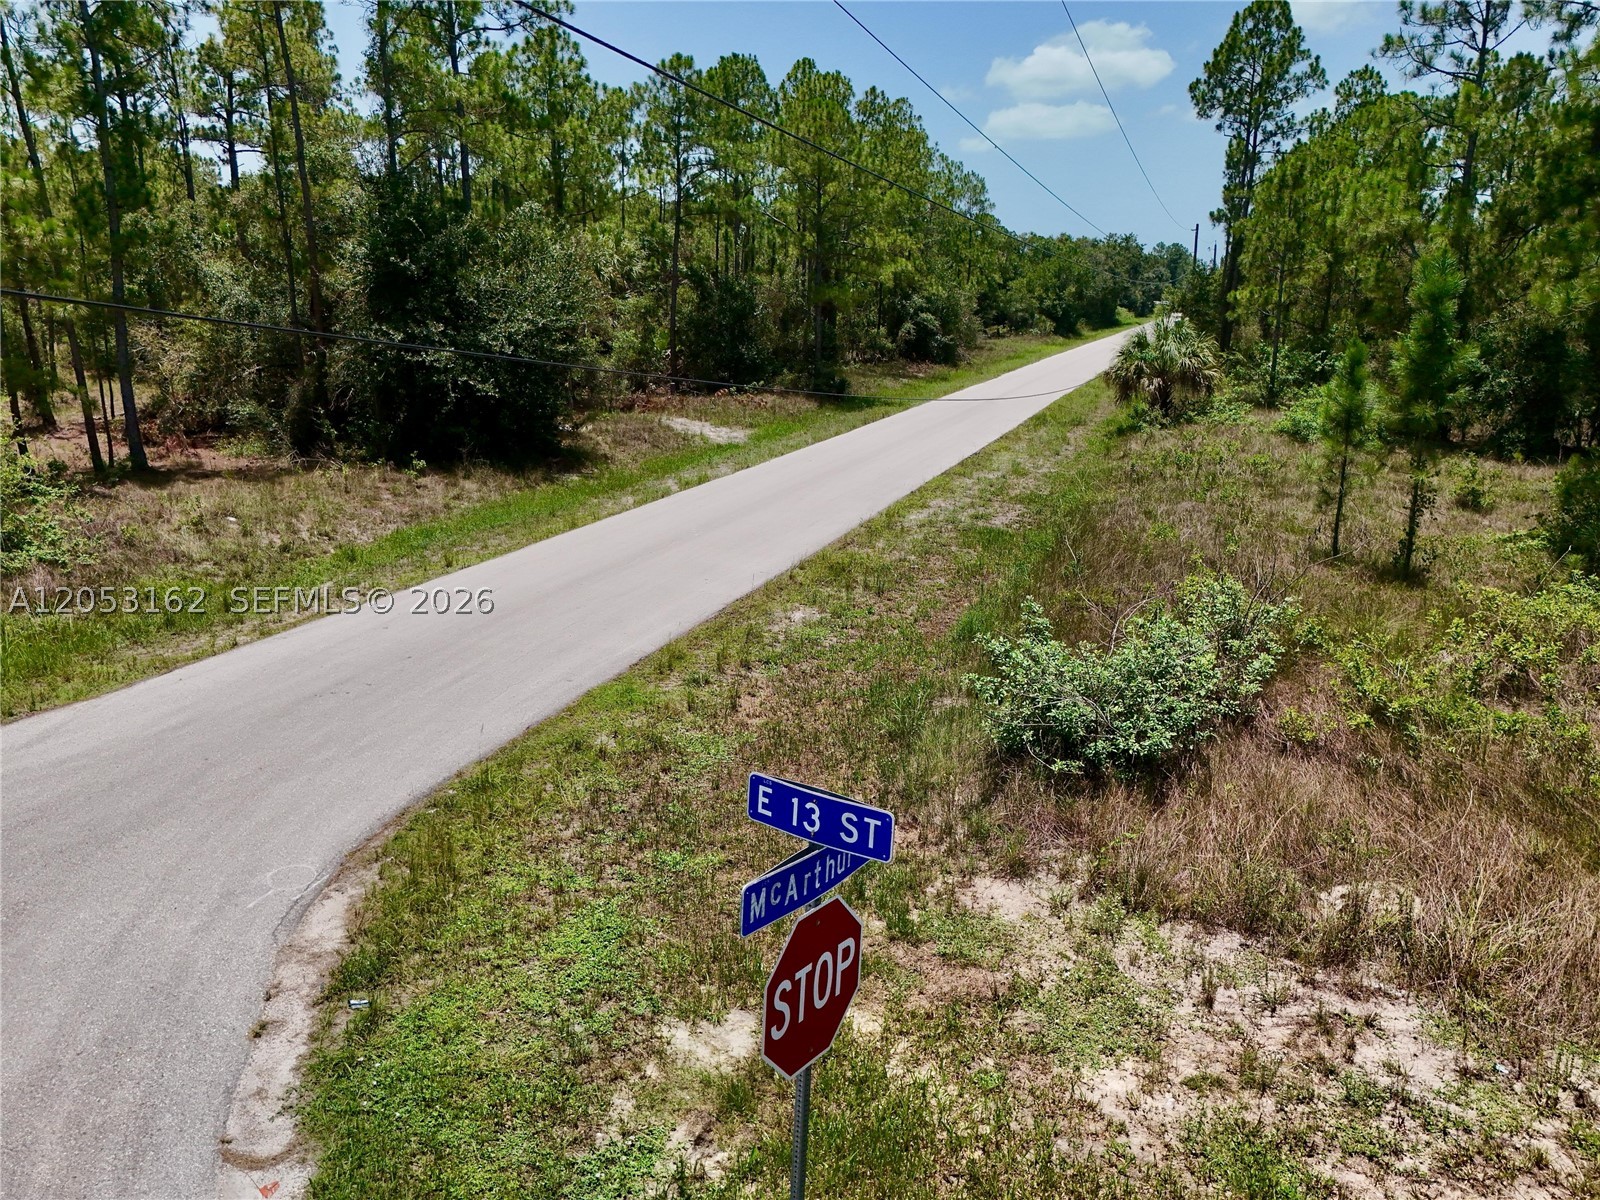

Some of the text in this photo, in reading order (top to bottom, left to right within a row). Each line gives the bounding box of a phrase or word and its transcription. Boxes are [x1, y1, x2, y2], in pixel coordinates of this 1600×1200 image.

[757, 784, 882, 849] E 13 ST
[770, 937, 856, 1041] STOP
